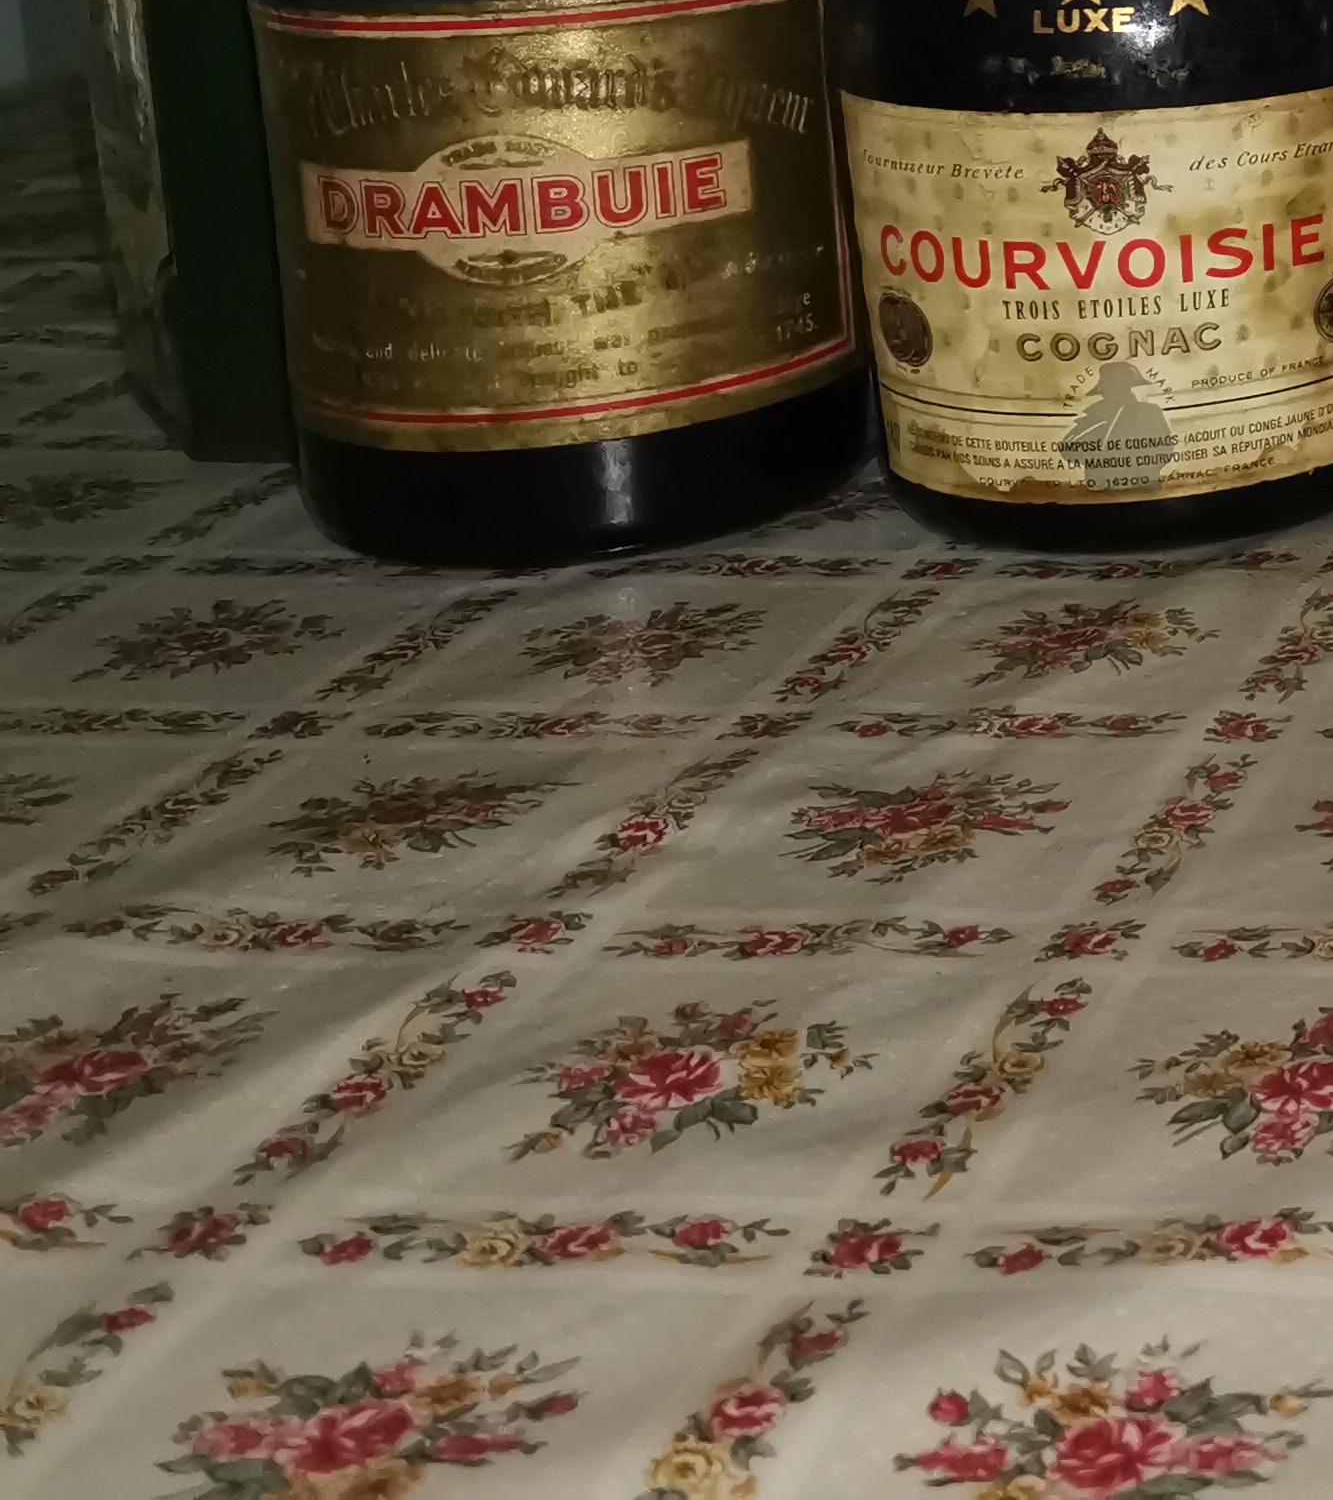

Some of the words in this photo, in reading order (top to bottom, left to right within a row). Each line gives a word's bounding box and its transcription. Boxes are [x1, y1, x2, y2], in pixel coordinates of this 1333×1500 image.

[1032, 6, 1137, 35] LUXE
[1189, 155, 1228, 172] des
[1236, 148, 1288, 167] Cours
[316, 151, 728, 240] DRAMBUIE
[1002, 299, 1060, 320] TROIS
[1078, 295, 1162, 319] ETOILES
[1180, 287, 1230, 313] LUXE
[1015, 321, 1223, 362] COGNAC
[1062, 365, 1095, 409] TRADE
[1145, 366, 1177, 404] MARK
[1191, 369, 1253, 389] PRODUCE
[1259, 365, 1276, 379] OF
[1281, 354, 1324, 373] FRANCE
[965, 436, 992, 450] CETTE
[995, 439, 1047, 452] BOUTEILLE
[1107, 440, 1121, 451] DE
[1230, 423, 1244, 438] OU
[1284, 408, 1316, 426] JAUNE
[1003, 458, 1011, 468] A
[1057, 459, 1065, 470] A
[1085, 457, 1133, 470] MARQUE
[1136, 447, 1208, 467] COURVOISIER
[1212, 445, 1227, 457] SA
[1223, 456, 1275, 473] FRANCE
